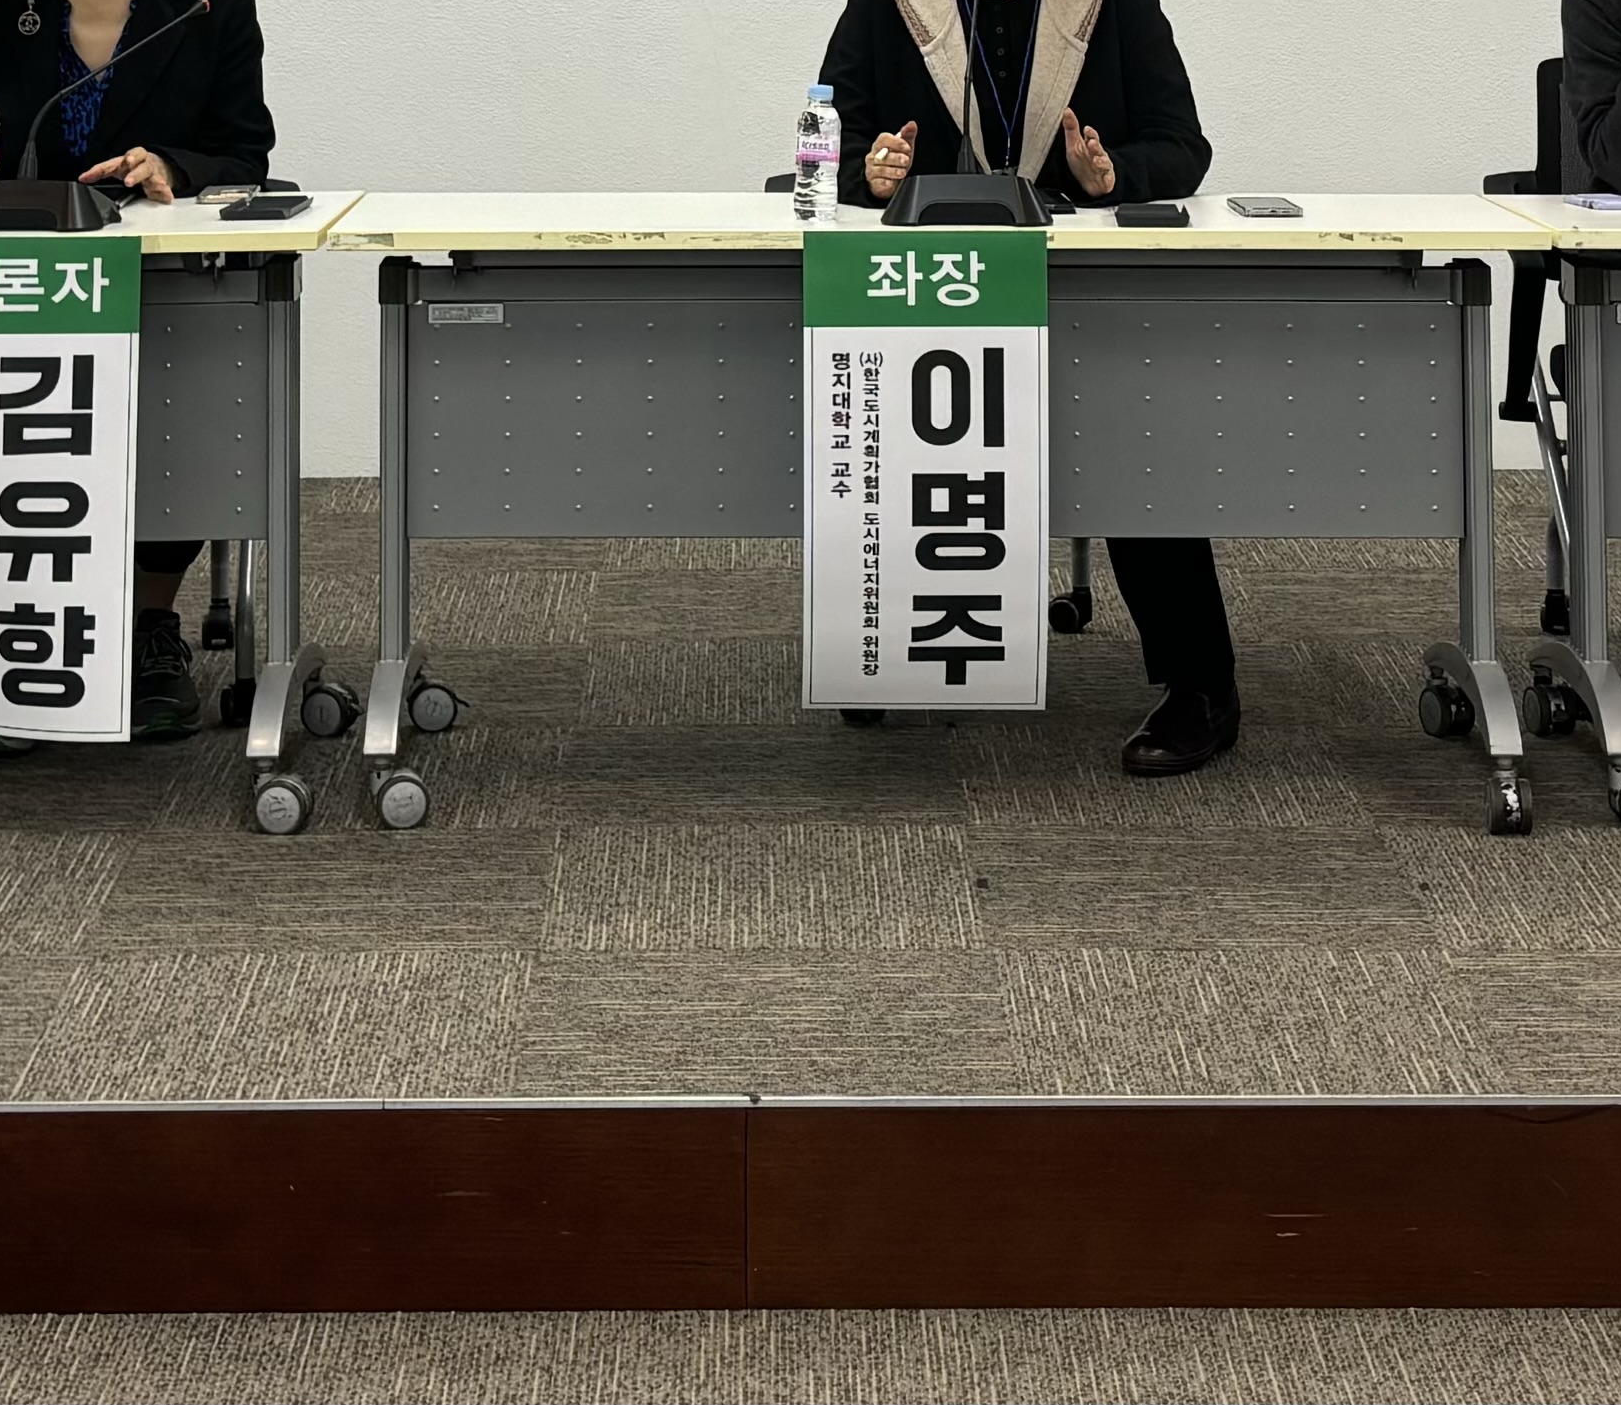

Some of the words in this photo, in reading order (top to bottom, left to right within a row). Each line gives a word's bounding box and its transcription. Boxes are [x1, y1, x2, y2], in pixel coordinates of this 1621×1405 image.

[866, 250, 986, 307] 좌장
[830, 352, 852, 449] 명지대학교
[859, 351, 884, 505] (사)한국도시계획가협회
[830, 462, 852, 499] 교수
[907, 347, 1007, 686] 이명주
[862, 512, 880, 630] 도시에너지위원회
[861, 635, 880, 676] 위원장
